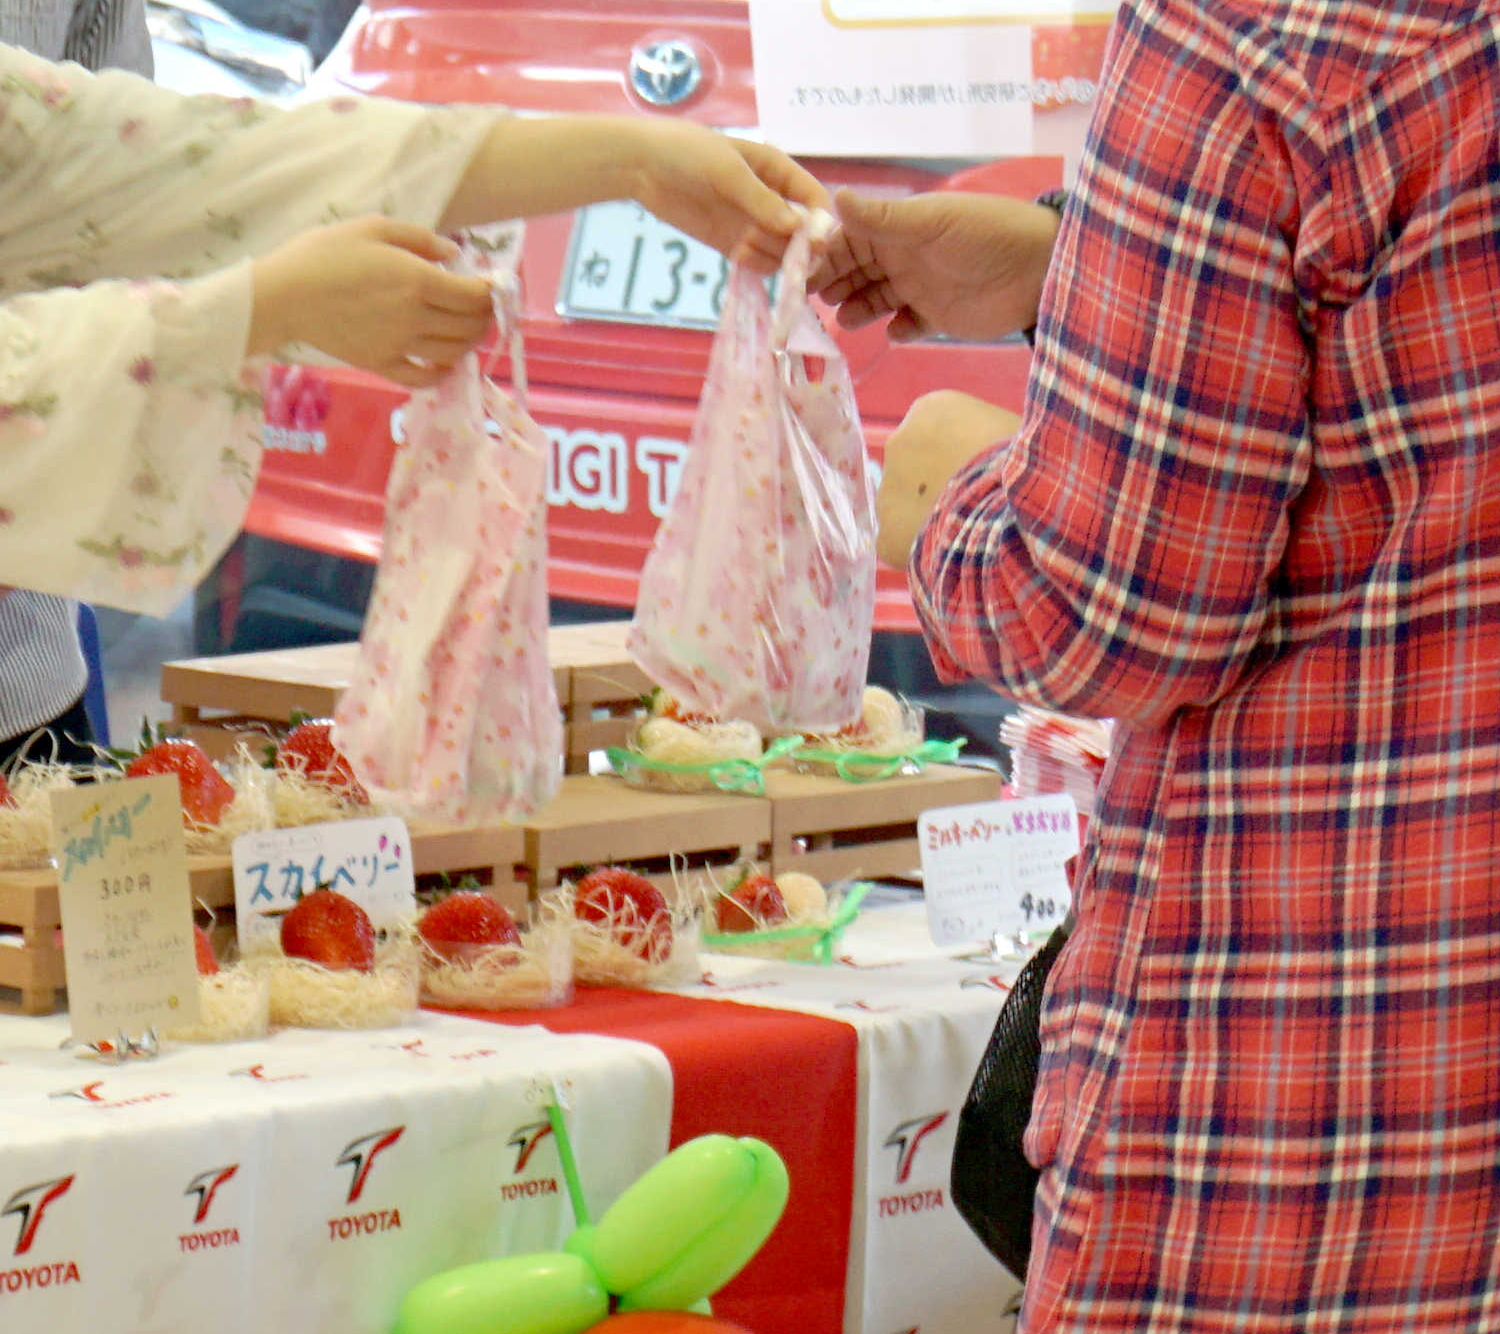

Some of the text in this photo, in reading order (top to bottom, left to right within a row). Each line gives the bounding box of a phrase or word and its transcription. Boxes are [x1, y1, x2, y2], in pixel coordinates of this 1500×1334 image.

[245, 854, 400, 905] スカイベリー
[500, 1176, 559, 1200] TOYOTA
[879, 1186, 945, 1217] TOYOTA
[327, 1207, 401, 1240] TOYOTA
[178, 1228, 241, 1252] TOYOTA
